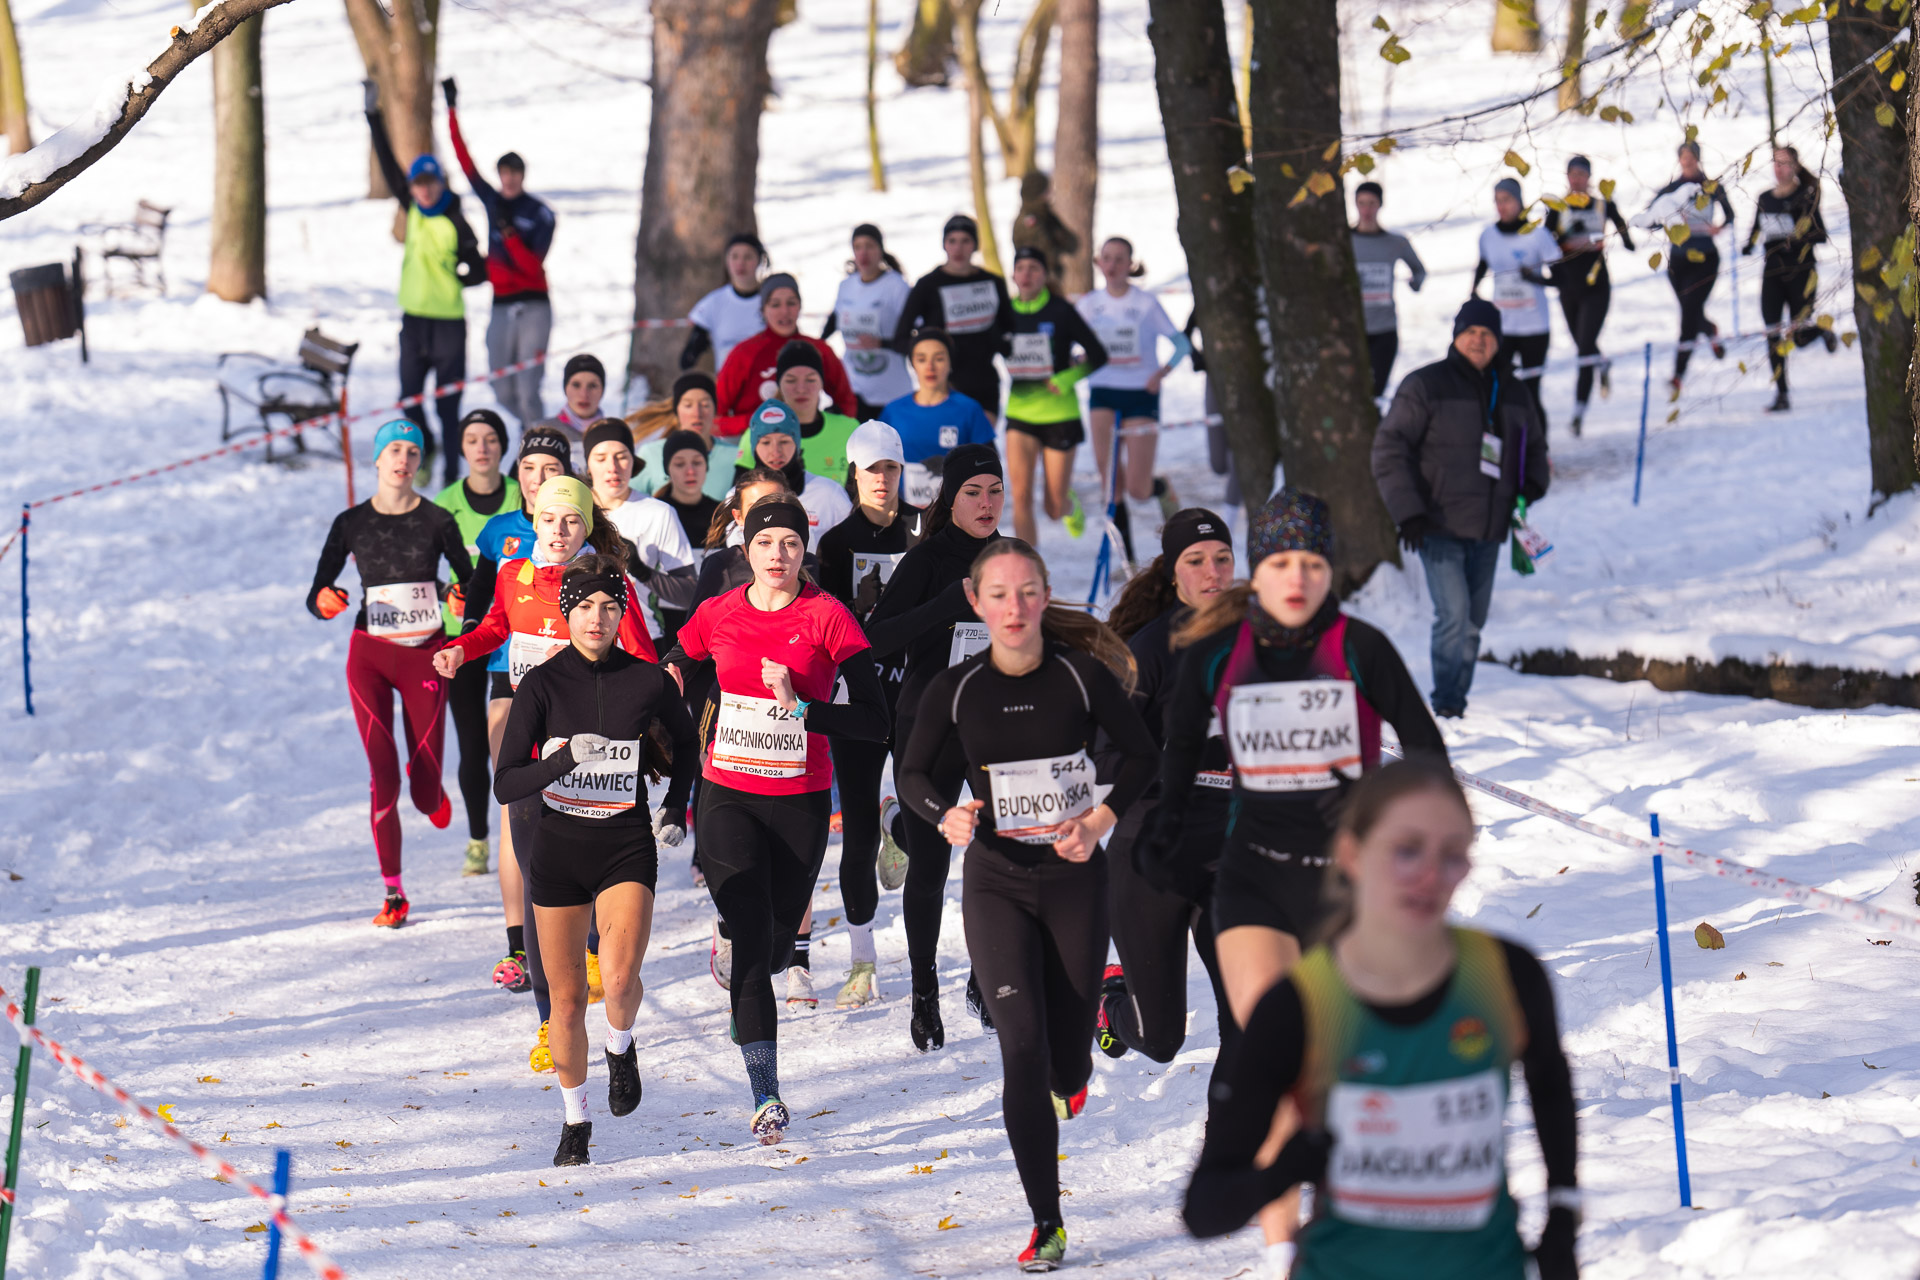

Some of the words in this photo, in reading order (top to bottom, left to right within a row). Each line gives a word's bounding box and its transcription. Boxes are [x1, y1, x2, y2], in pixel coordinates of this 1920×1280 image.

[527, 437, 567, 453] RUN
[412, 586, 427, 599] 31
[371, 609, 437, 626] HARASYM
[965, 629, 978, 637] 770
[513, 662, 539, 677] ŁA
[1299, 688, 1343, 710] 397
[719, 726, 804, 751] MACHNIKOWSKA
[1236, 724, 1352, 752] WALCZAK
[733, 765, 762, 774] BYTOM
[763, 769, 783, 777] 2024
[1050, 758, 1087, 779] 544
[1208, 777, 1231, 786] 2024
[998, 782, 1091, 818] BUDKOWSKA
[559, 804, 589, 815] BYTOM
